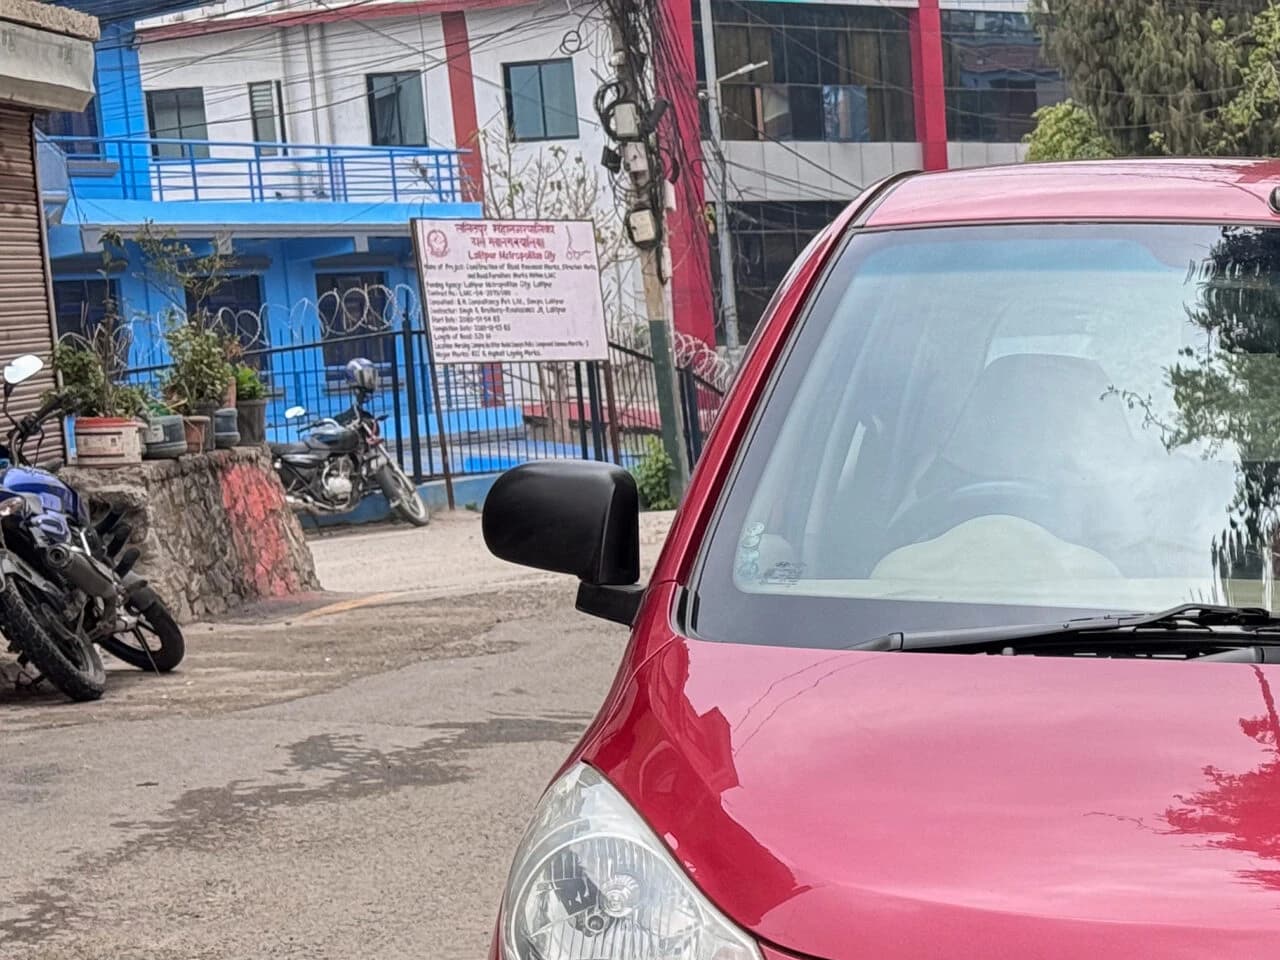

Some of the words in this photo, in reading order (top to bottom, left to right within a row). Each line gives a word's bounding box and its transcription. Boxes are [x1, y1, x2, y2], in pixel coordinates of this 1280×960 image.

[468, 251, 496, 263] Lalitpur
[499, 251, 542, 262] Metropolitan
[544, 251, 556, 263] City
[486, 281, 518, 290] Metropolitan
